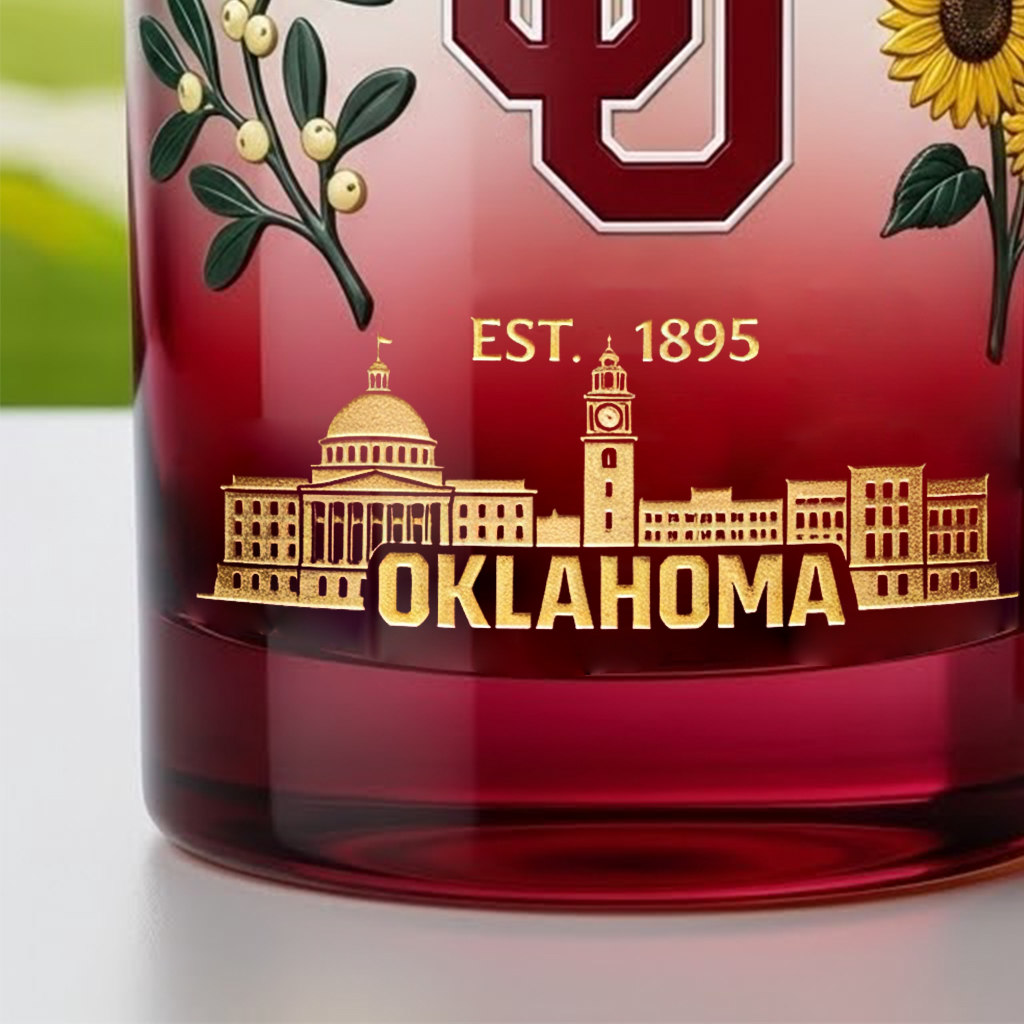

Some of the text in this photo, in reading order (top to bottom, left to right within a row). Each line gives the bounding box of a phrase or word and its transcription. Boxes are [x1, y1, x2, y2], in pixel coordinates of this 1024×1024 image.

[469, 316, 761, 364] EST. 1895
[376, 551, 847, 631] OKLAHOMA
